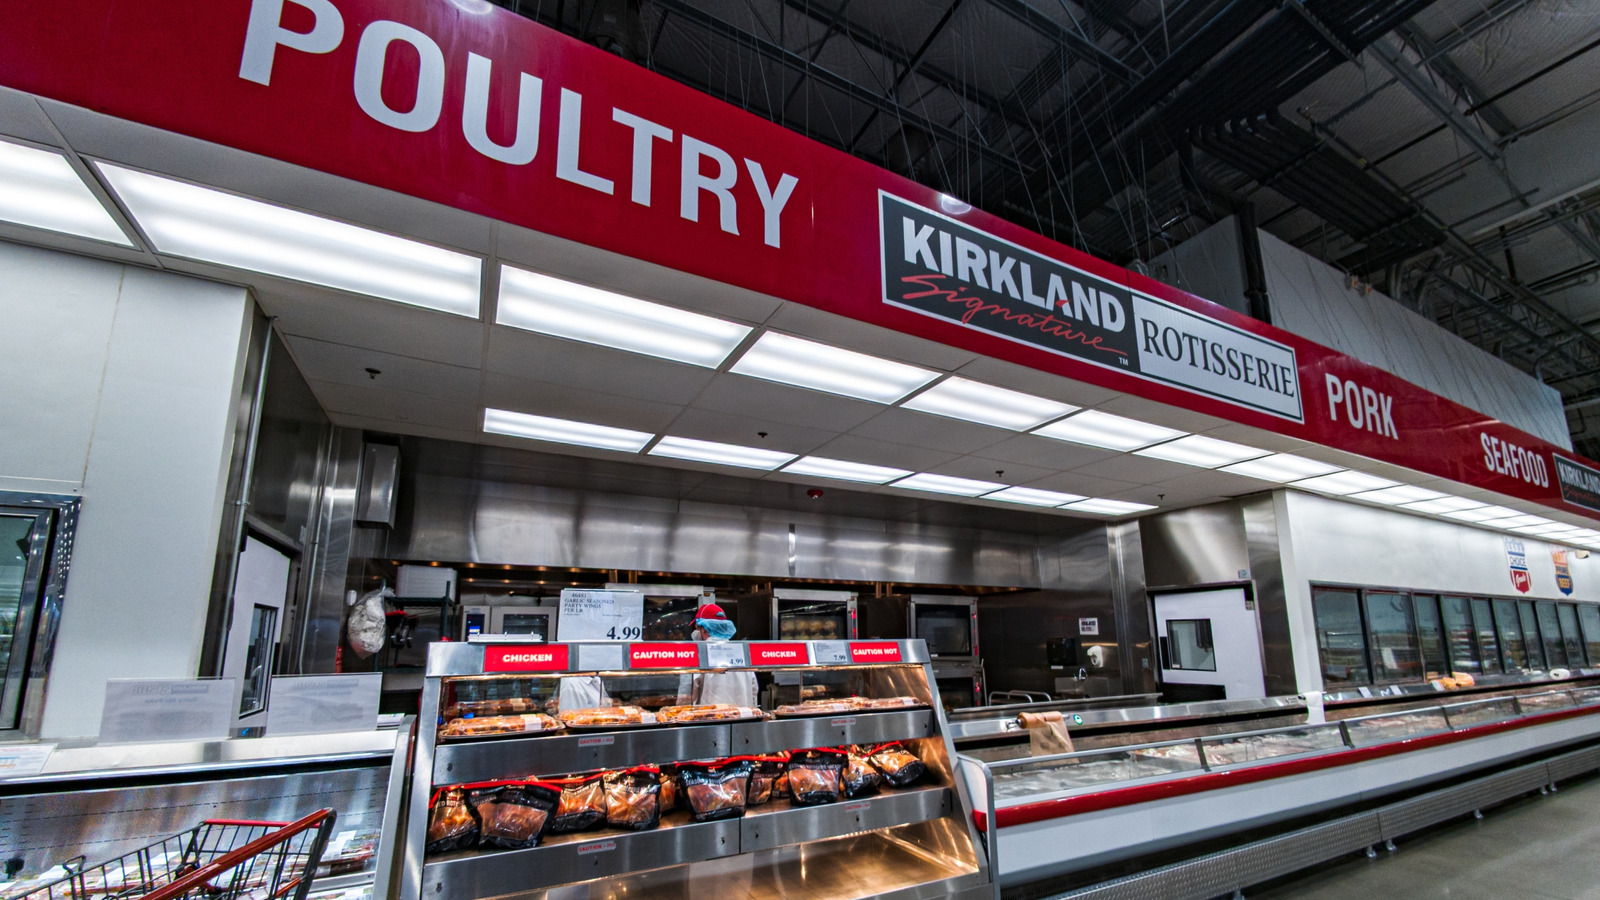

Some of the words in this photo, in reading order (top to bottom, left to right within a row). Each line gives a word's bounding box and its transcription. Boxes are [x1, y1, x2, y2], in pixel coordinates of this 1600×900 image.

[238, 0, 799, 249] POULTRY
[902, 216, 1126, 333] KIRKLAND
[901, 274, 1128, 356] Signature
[1139, 317, 1295, 398] ROTISSERIE
[1325, 373, 1399, 440] PORK
[1480, 432, 1549, 488] SEAFOOD
[502, 653, 553, 662] CHICKEN
[606, 626, 641, 640] 4.99
[632, 651, 675, 659] CAUTION
[761, 650, 797, 658] CHICKEN
